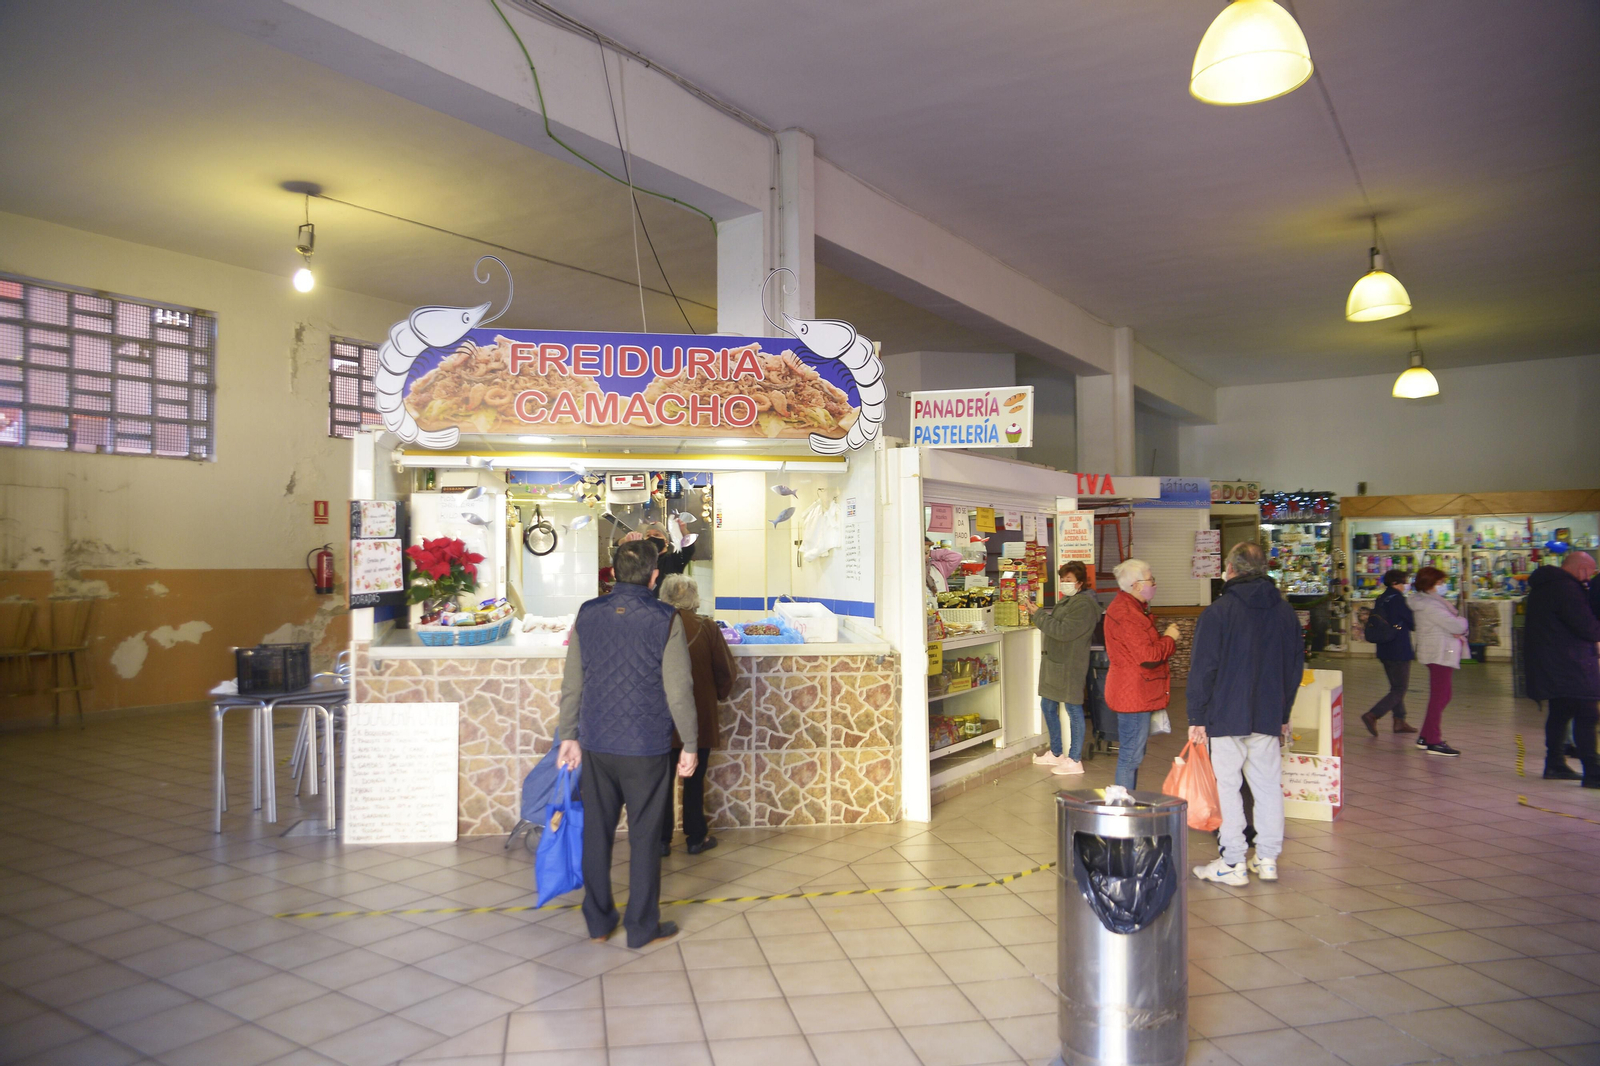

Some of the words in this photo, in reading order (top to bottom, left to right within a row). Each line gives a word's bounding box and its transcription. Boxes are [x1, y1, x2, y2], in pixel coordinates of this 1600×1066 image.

[509, 342, 765, 381] FREIDURIA
[513, 390, 758, 428] CAMACHO
[914, 391, 1000, 419] PANADERÍA
[914, 418, 1000, 445] PASTELERÍA
